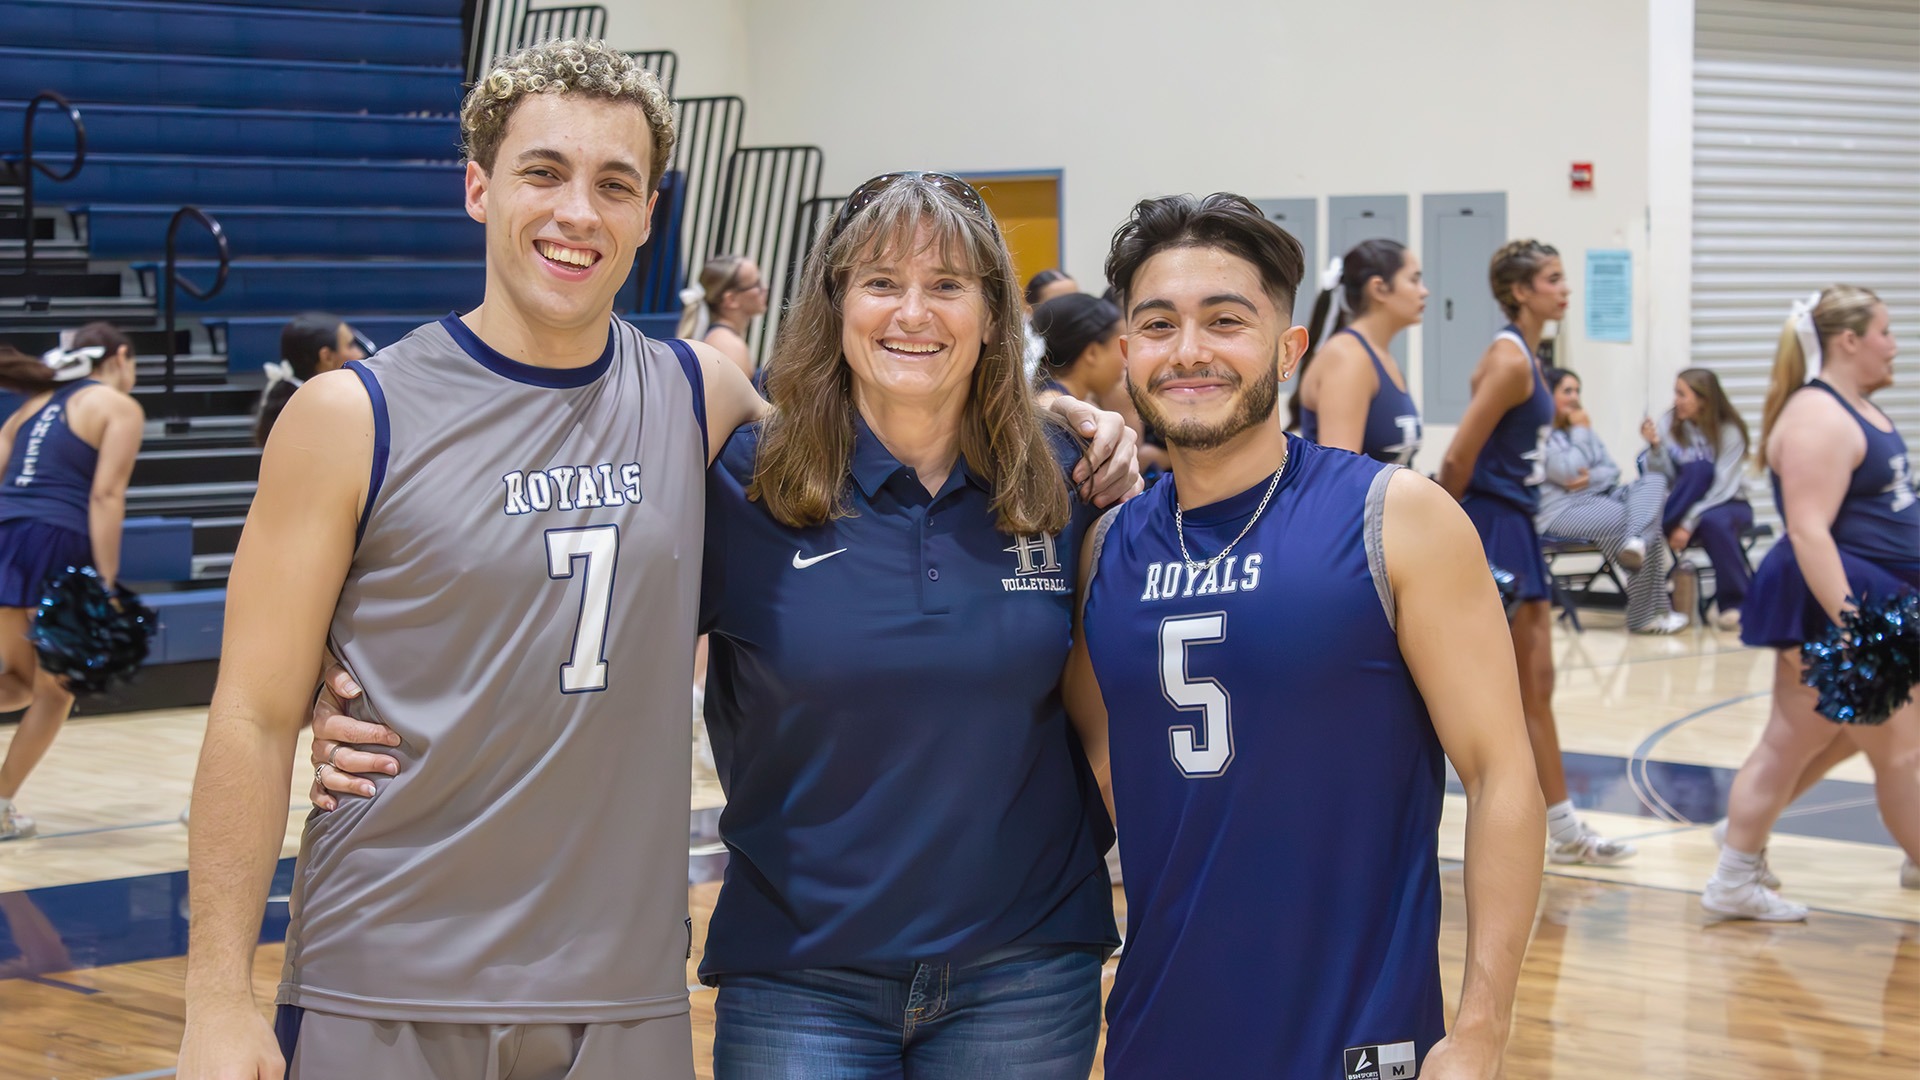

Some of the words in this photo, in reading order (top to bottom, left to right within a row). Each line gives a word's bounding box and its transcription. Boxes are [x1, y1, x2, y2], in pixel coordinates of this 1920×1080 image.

[502, 462, 643, 515] ROYALS
[1001, 578, 1067, 592] VOLLEYBALL
[1140, 552, 1264, 602] ROYALS
[543, 523, 620, 694] 7
[1158, 610, 1236, 779] 5
[1392, 1064, 1405, 1076] M
